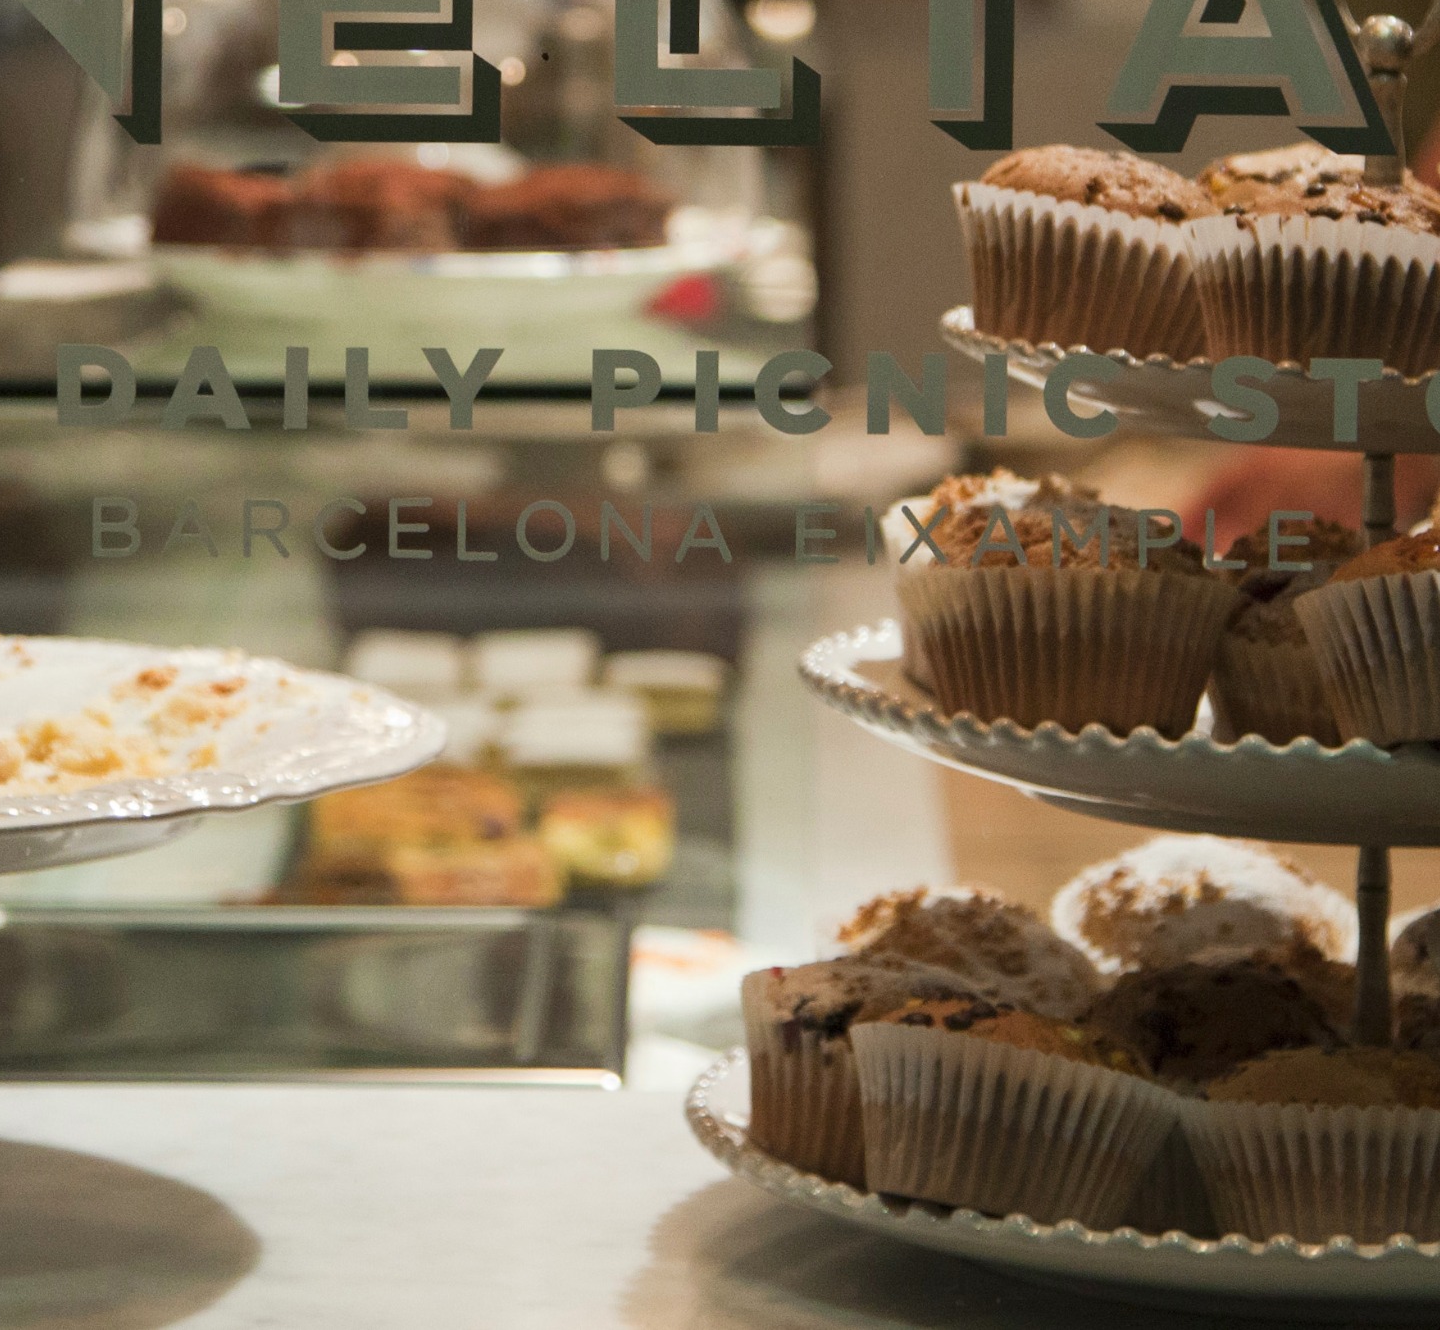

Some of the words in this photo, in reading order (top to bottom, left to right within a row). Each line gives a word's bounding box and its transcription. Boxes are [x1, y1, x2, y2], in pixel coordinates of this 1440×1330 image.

[55, 343, 505, 431] DAILY
[590, 347, 1122, 440] PICNIC
[91, 497, 733, 563] BARCELONA
[794, 504, 1315, 572] EIXAMPLE
